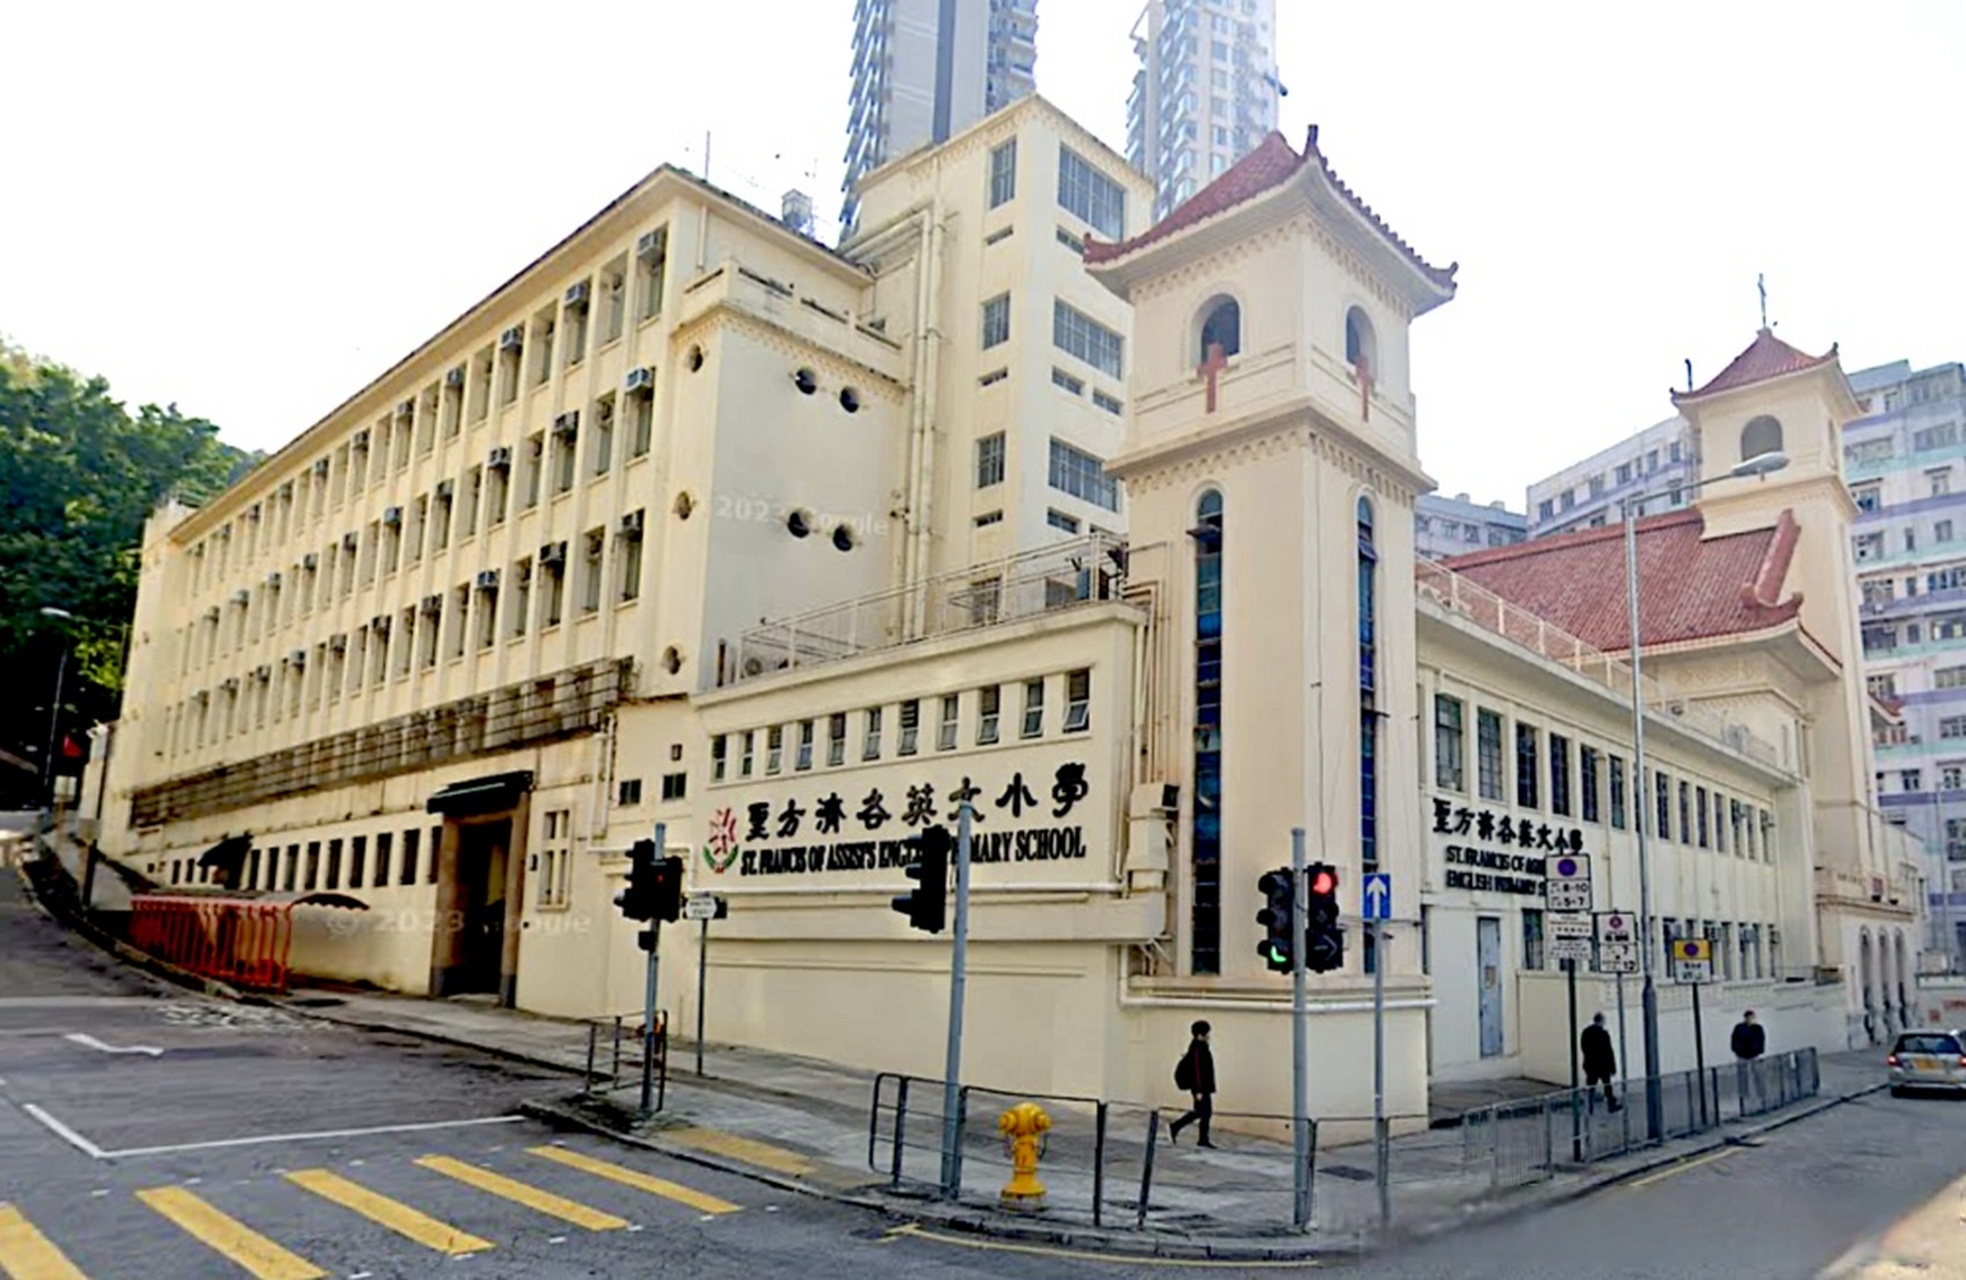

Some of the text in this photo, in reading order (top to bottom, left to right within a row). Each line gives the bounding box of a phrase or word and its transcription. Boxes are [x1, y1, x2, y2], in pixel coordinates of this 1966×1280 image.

[760, 847, 807, 875] FRANCIS
[809, 844, 826, 872] OF
[1015, 826, 1086, 862] SCHOOL
[1465, 847, 1510, 870] FRANCIS
[1446, 869, 1492, 891] ENGLISH
